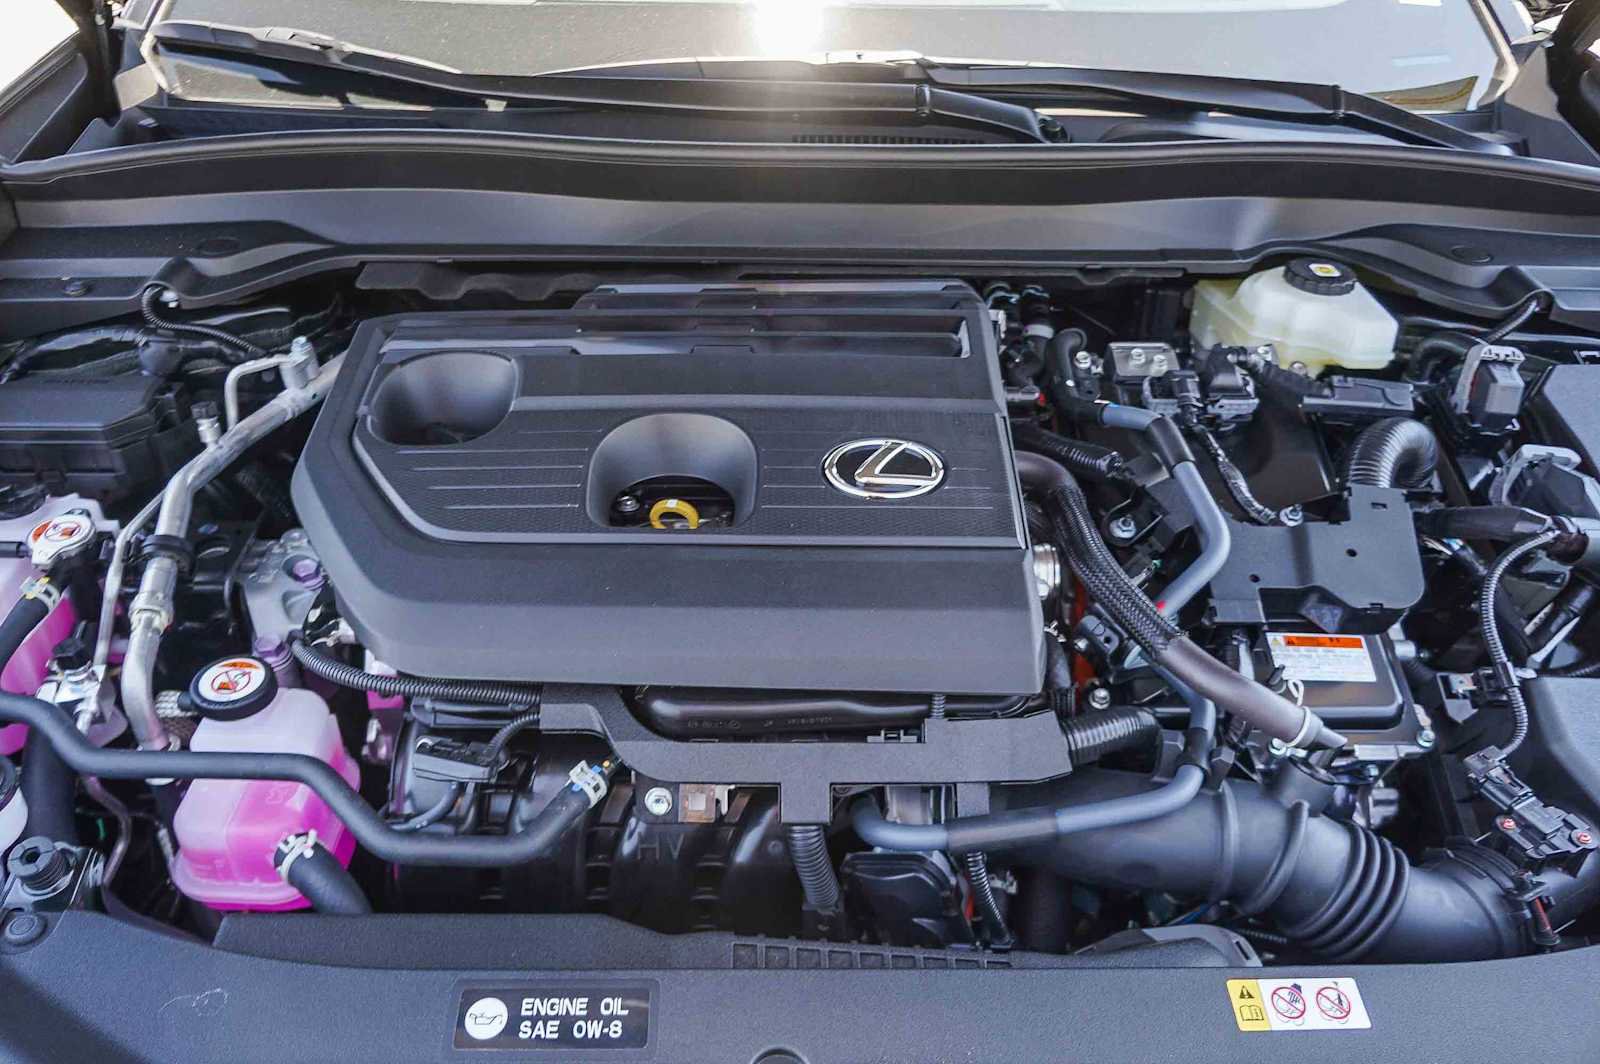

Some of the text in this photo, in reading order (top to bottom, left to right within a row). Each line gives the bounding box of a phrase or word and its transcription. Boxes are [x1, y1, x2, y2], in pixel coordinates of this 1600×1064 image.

[520, 997, 629, 1016] ENGINE OIL
[518, 1020, 560, 1039] SAE
